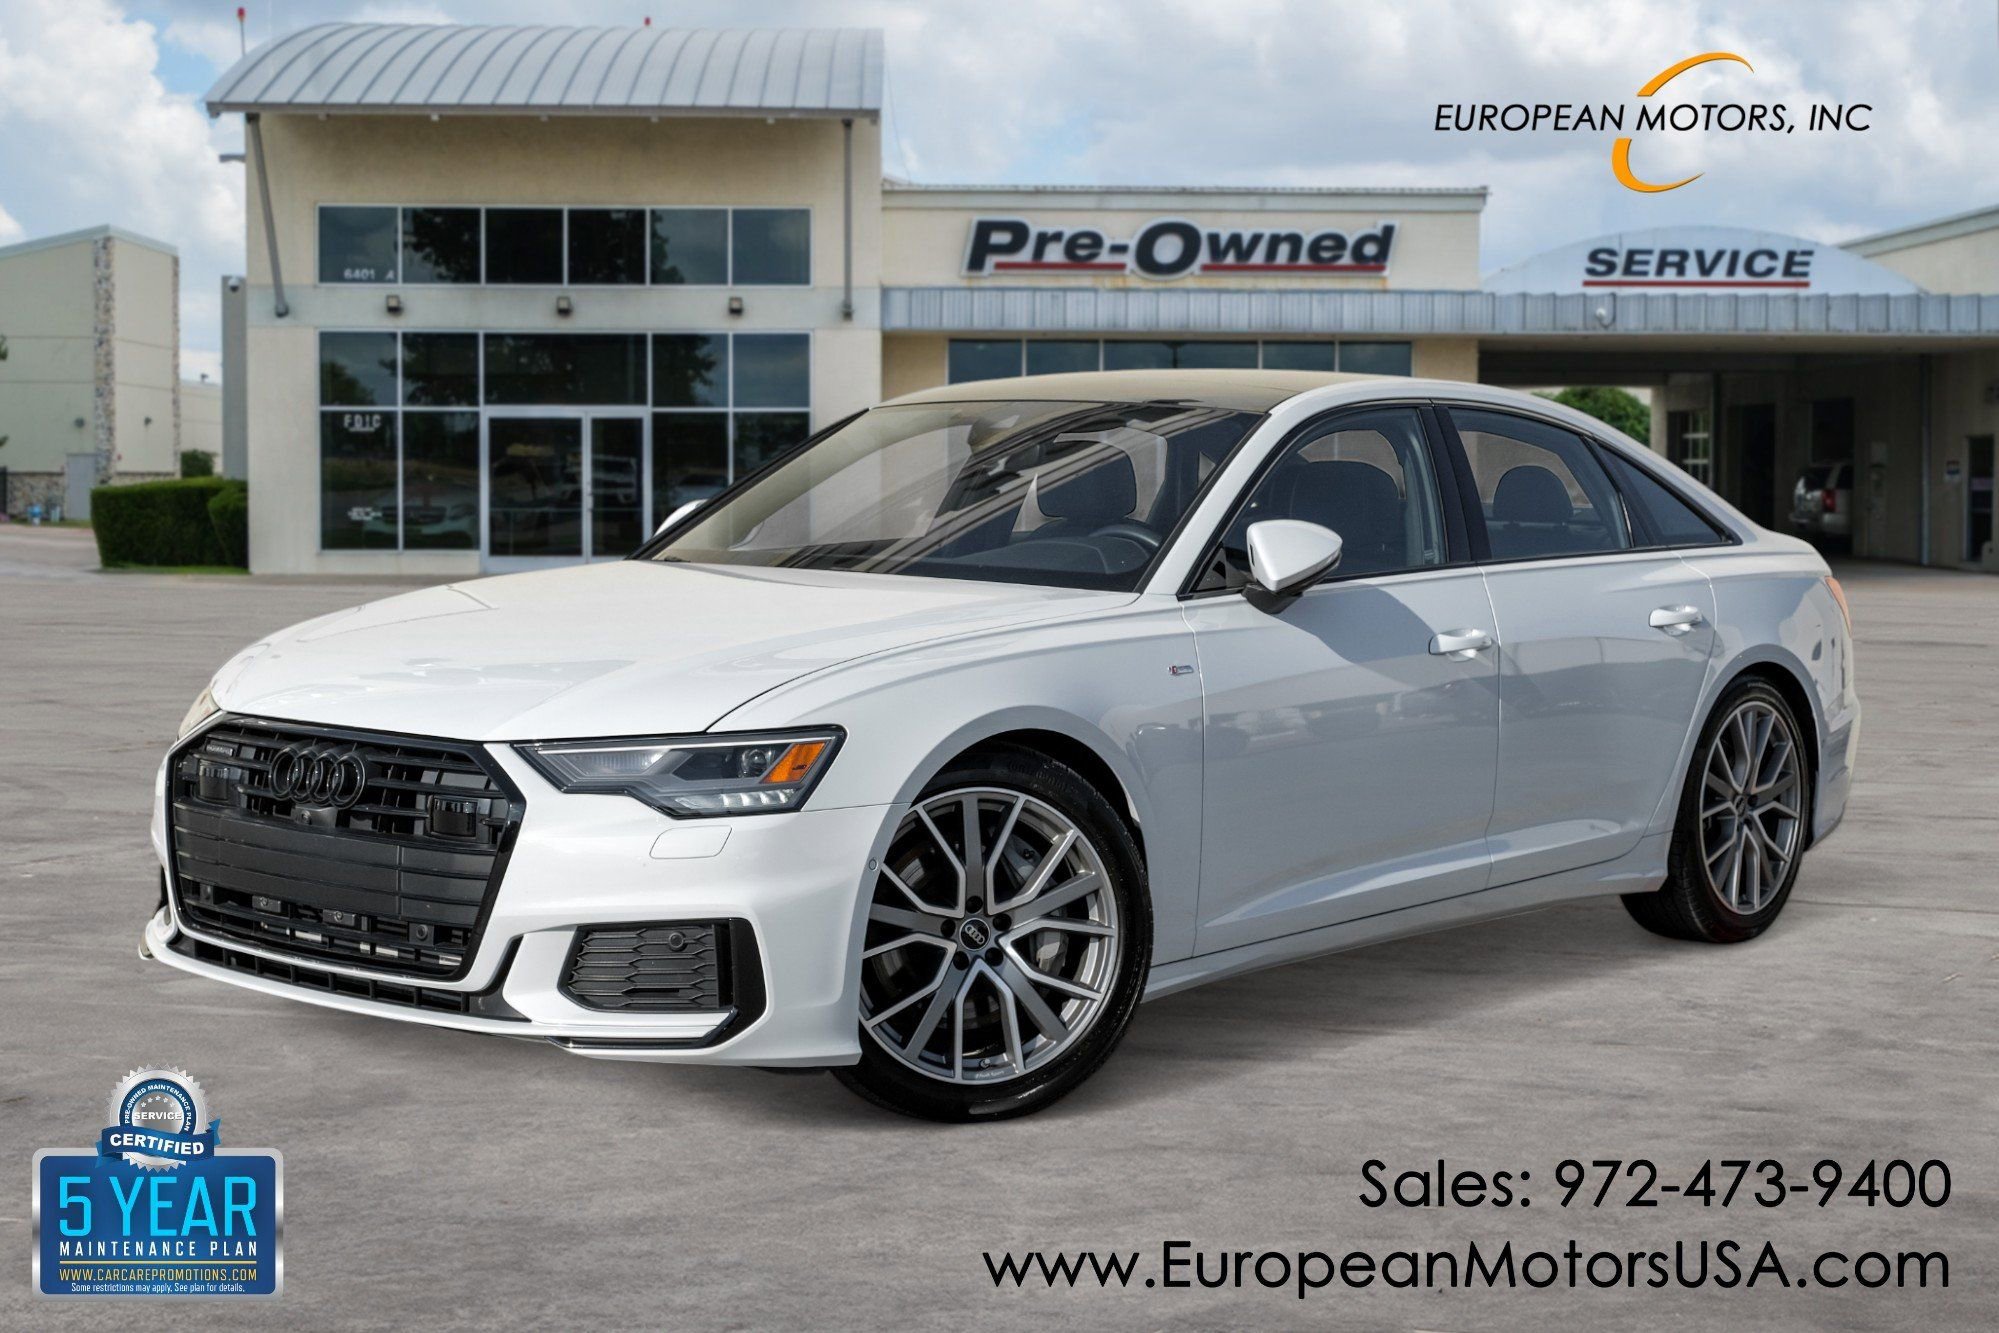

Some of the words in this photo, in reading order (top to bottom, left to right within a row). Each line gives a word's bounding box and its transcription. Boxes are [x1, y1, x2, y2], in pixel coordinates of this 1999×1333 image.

[966, 219, 1396, 276] Pre-Owned
[343, 268, 376, 280] 6401
[1585, 248, 1814, 277] SERVICE
